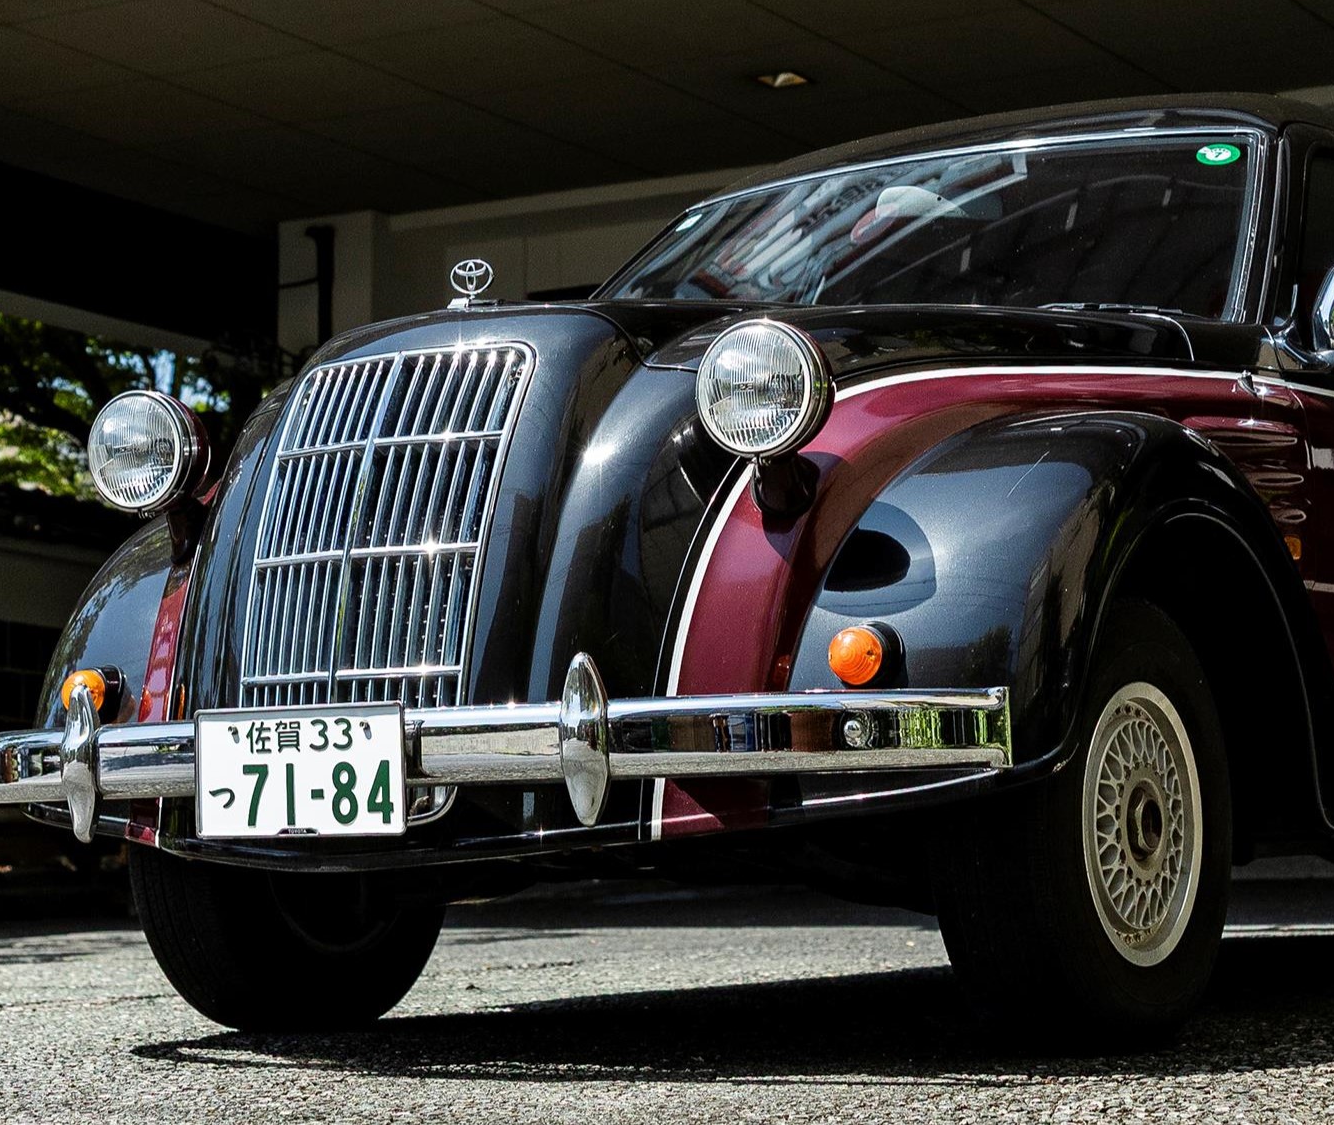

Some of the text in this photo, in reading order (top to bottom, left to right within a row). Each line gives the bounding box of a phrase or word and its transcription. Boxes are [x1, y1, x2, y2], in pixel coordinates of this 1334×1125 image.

[246, 718, 353, 754] 佐賀 33
[209, 759, 395, 827] つ 71-84
